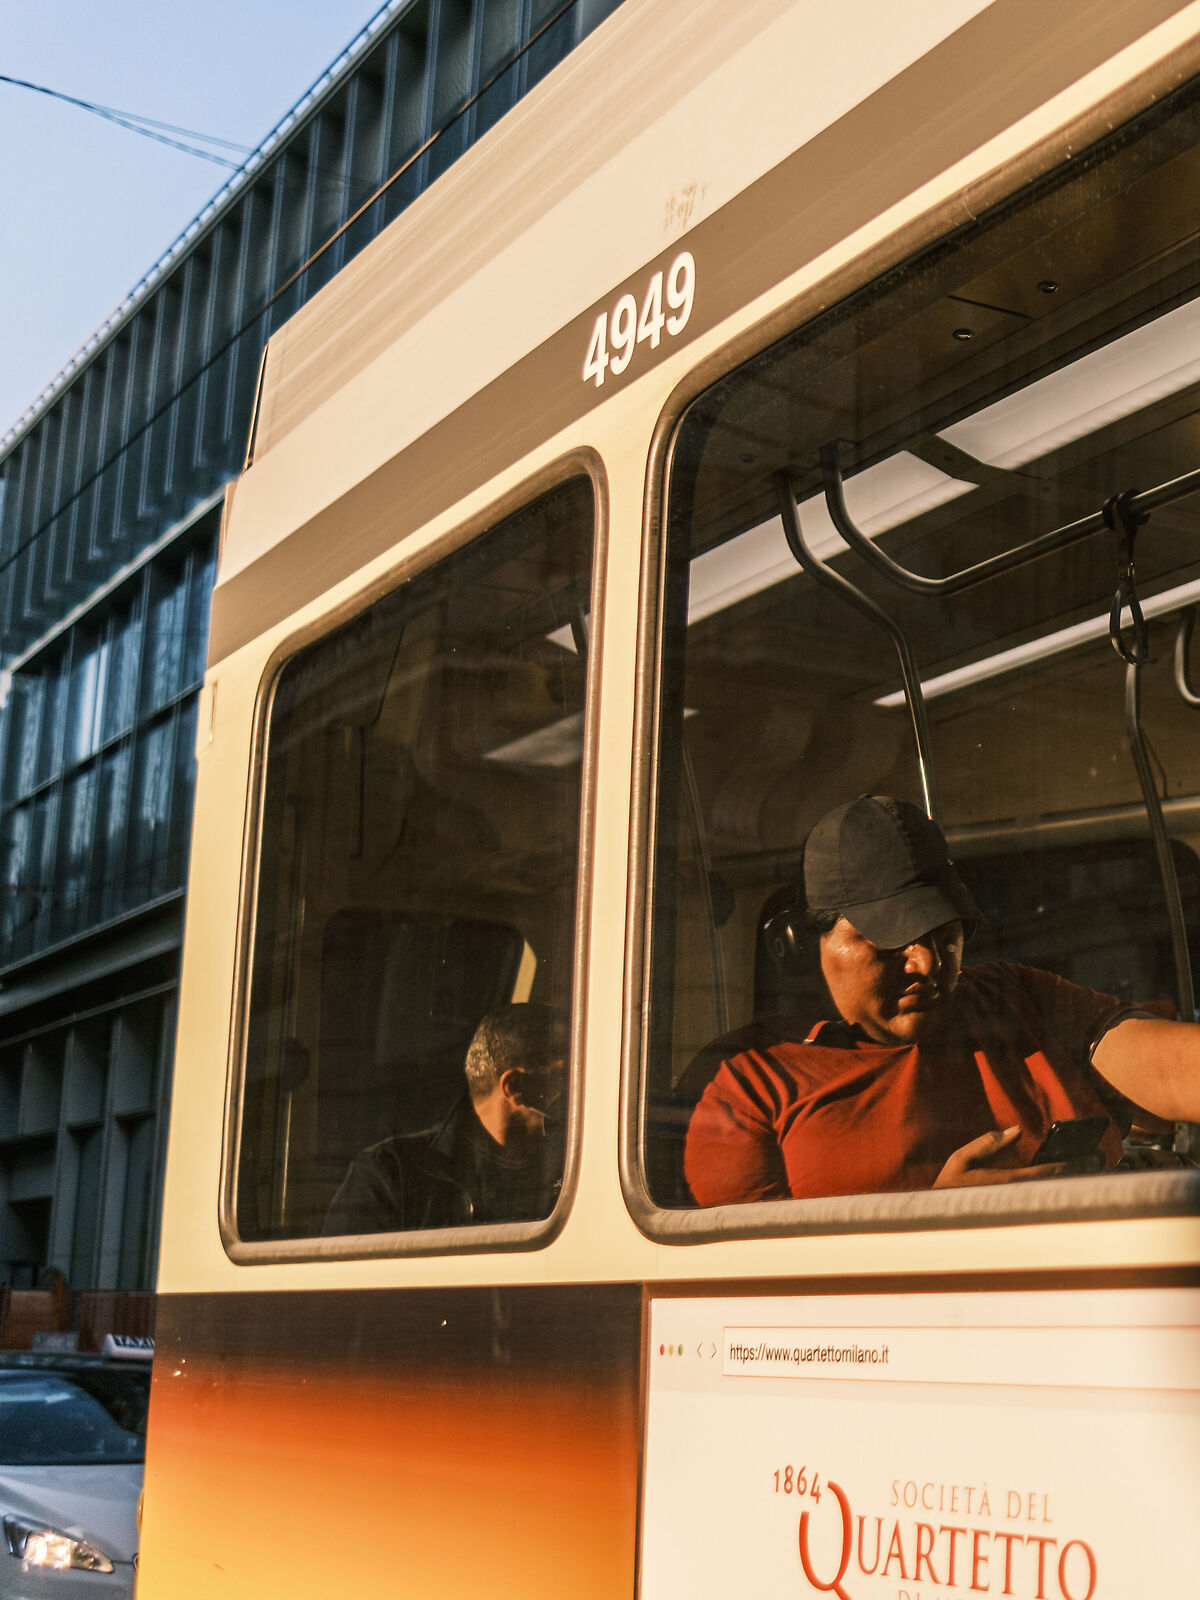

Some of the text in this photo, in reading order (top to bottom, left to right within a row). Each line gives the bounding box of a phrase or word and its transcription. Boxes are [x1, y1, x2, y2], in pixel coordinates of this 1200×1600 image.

[582, 251, 696, 388] 4949
[729, 1343, 890, 1366] https://www.quartettomilano.it
[773, 1464, 823, 1504] 1864
[890, 1479, 1054, 1523] SOCIETÀ DEL
[797, 1480, 1098, 1600] QUARTETTO
